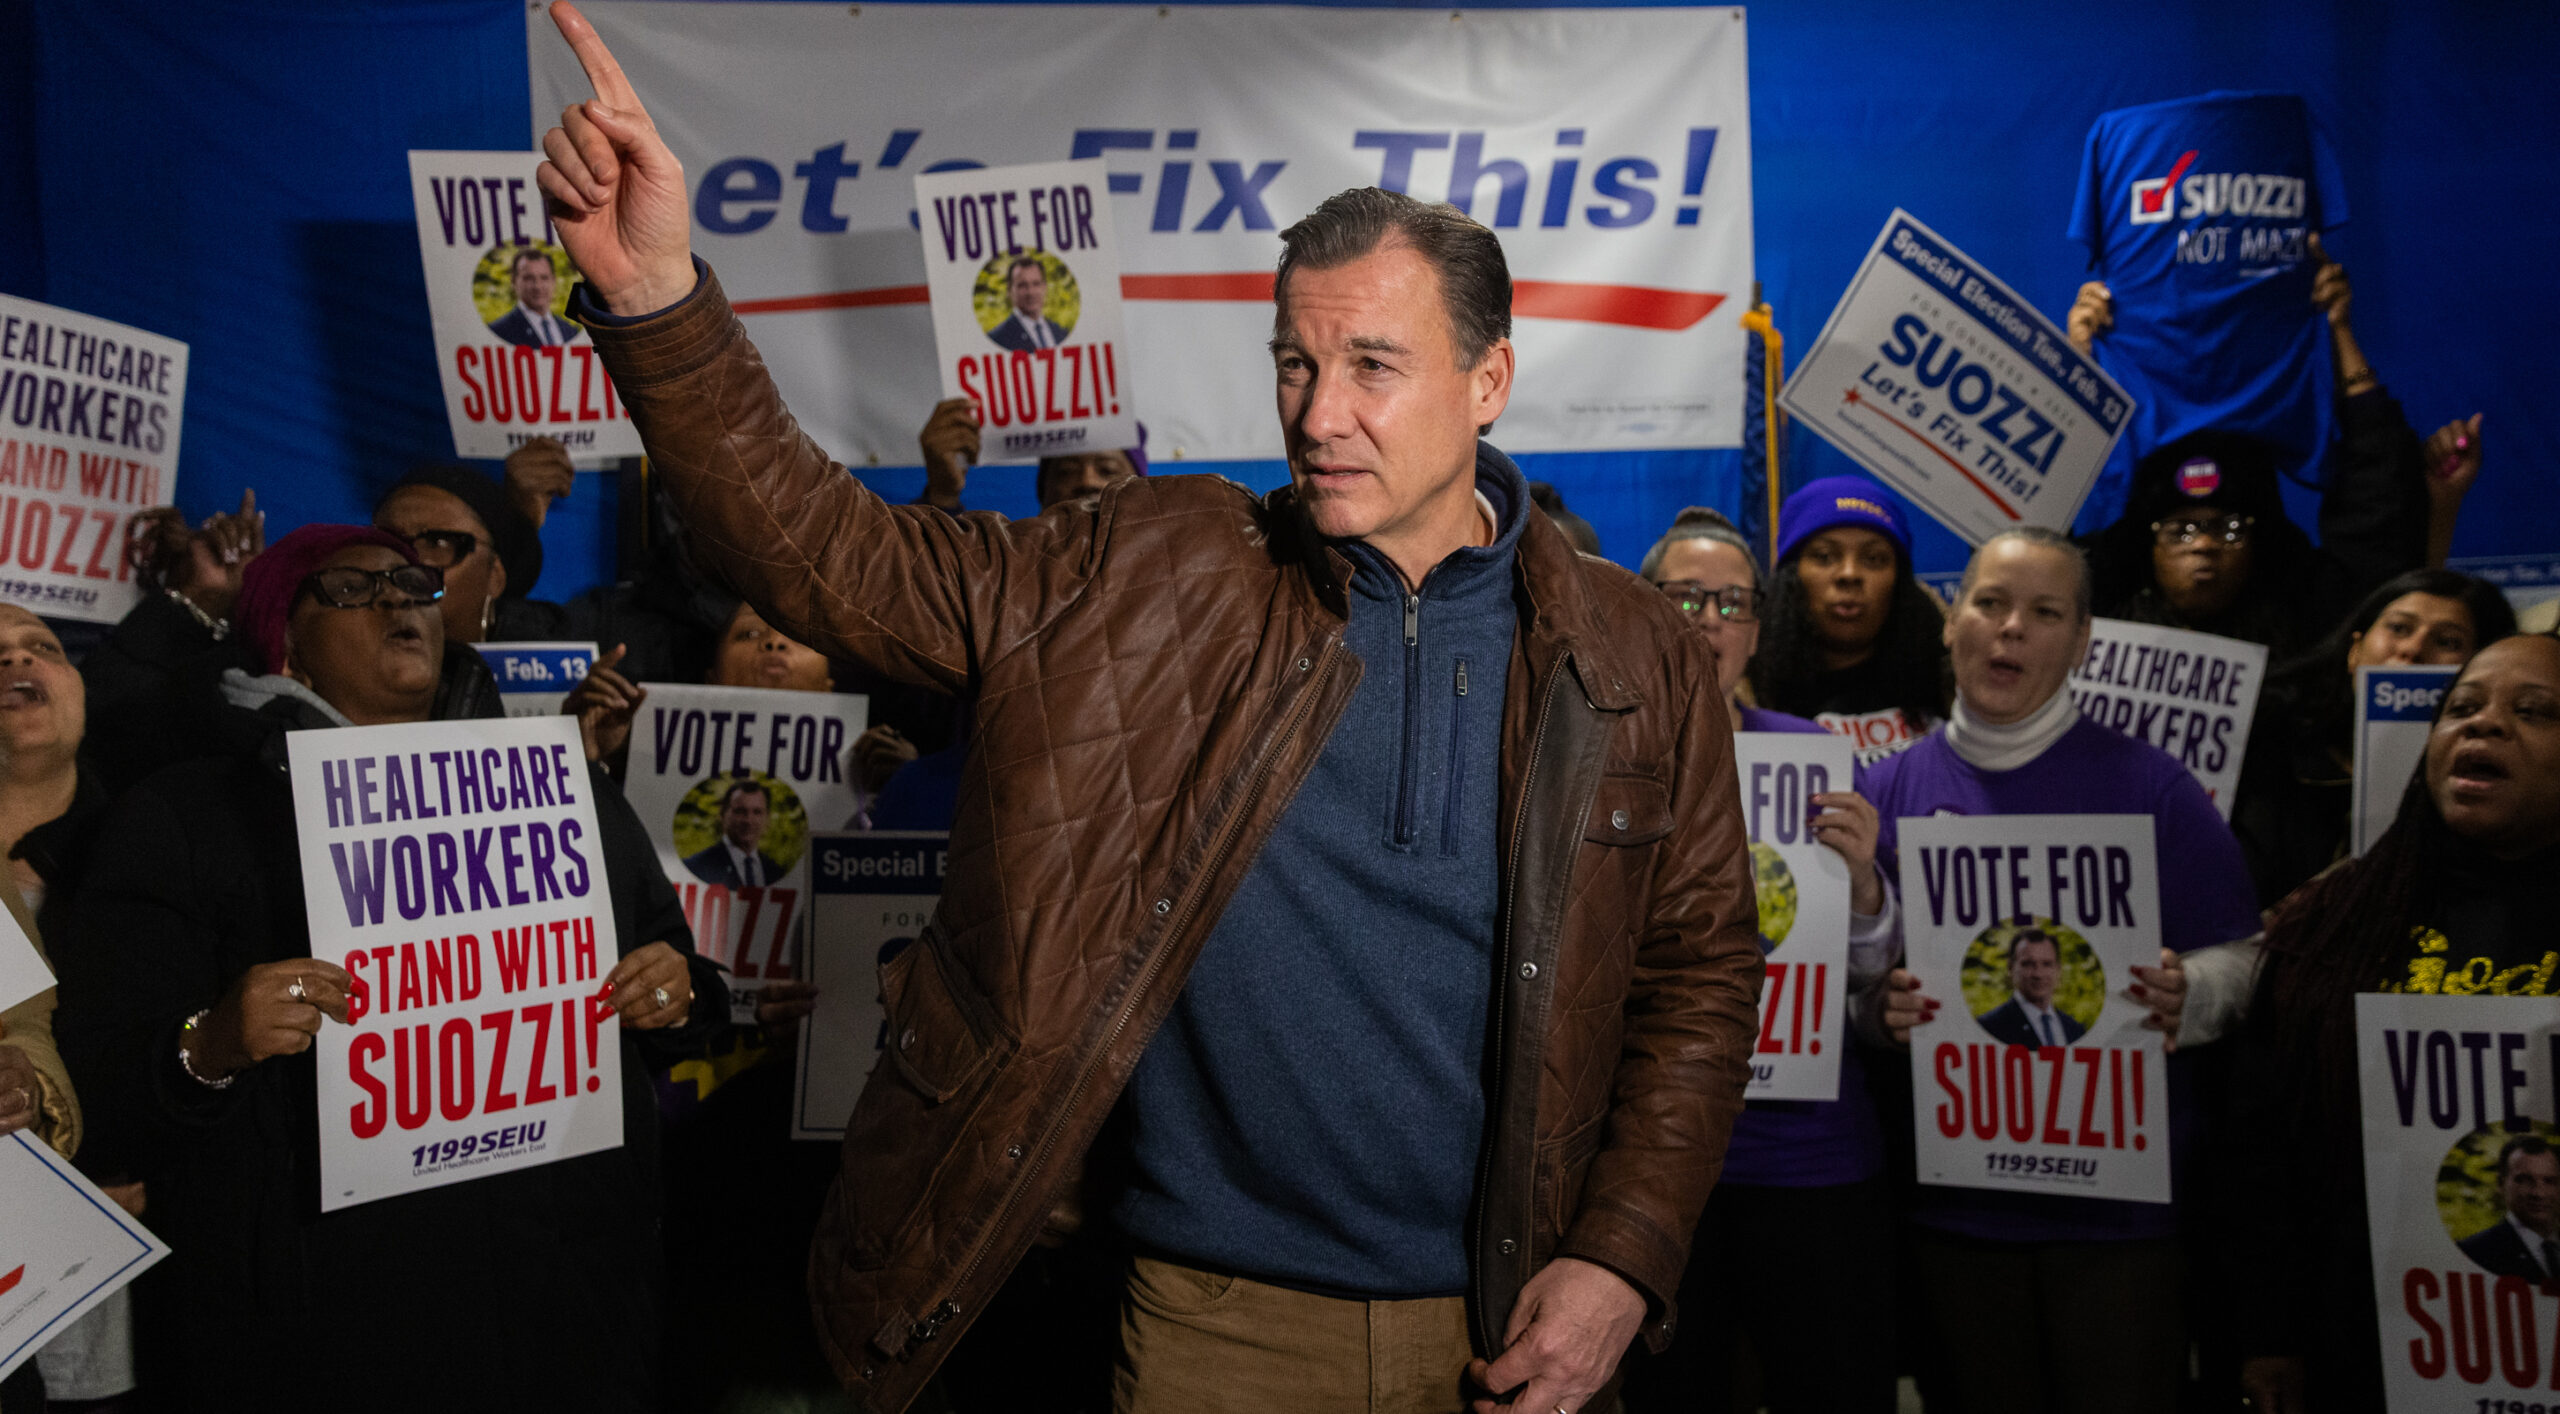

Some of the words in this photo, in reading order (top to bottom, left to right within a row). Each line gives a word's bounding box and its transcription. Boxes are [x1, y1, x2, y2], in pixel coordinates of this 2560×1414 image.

[430, 176, 531, 248] VOTE
[692, 128, 990, 236] et'
[1352, 128, 1719, 229] This!
[2180, 173, 2305, 219] SUOZZI
[934, 190, 1023, 263] VOTE
[1030, 184, 1098, 254] FOR
[2176, 226, 2232, 264] NOT
[0, 315, 172, 396] EALTHCARE
[1892, 228, 1961, 289] Special
[1959, 274, 2032, 347] Election
[2065, 362, 2102, 406] Feb.
[2102, 395, 2126, 424] 13
[457, 344, 630, 424] SUOZZI
[957, 342, 1120, 429] SUOZZI!
[1879, 312, 2066, 477] SUOZZI
[0, 438, 69, 493] AND
[80, 452, 160, 507] WITH
[1861, 362, 1927, 419] Let's
[1929, 412, 1971, 453] Fix
[1975, 445, 2043, 503] This!
[0, 496, 134, 582] UOZZI
[0, 577, 98, 604] 199SEIU
[504, 657, 554, 681] Feb.
[560, 657, 588, 681] 13
[2082, 639, 2247, 706] EALTHCARE
[2374, 681, 2443, 713] Spec
[322, 744, 575, 828] HEALTHCARE
[654, 708, 756, 780] VOTE
[768, 714, 844, 784] FOR
[329, 818, 590, 927] WORKERS
[822, 849, 925, 881] Special
[1919, 845, 2033, 927] VOTE
[2047, 845, 2136, 927] FOR
[882, 912, 925, 927] FOR
[345, 934, 481, 1019] STAND
[492, 916, 597, 993] WITH
[349, 995, 600, 1139] SUOZZI!
[1934, 1042, 2147, 1151] SUOZZI!
[2384, 1029, 2531, 1132] VOTE
[412, 1120, 546, 1168] 1199SEIU
[1986, 1152, 2099, 1178] 1199SEIU
